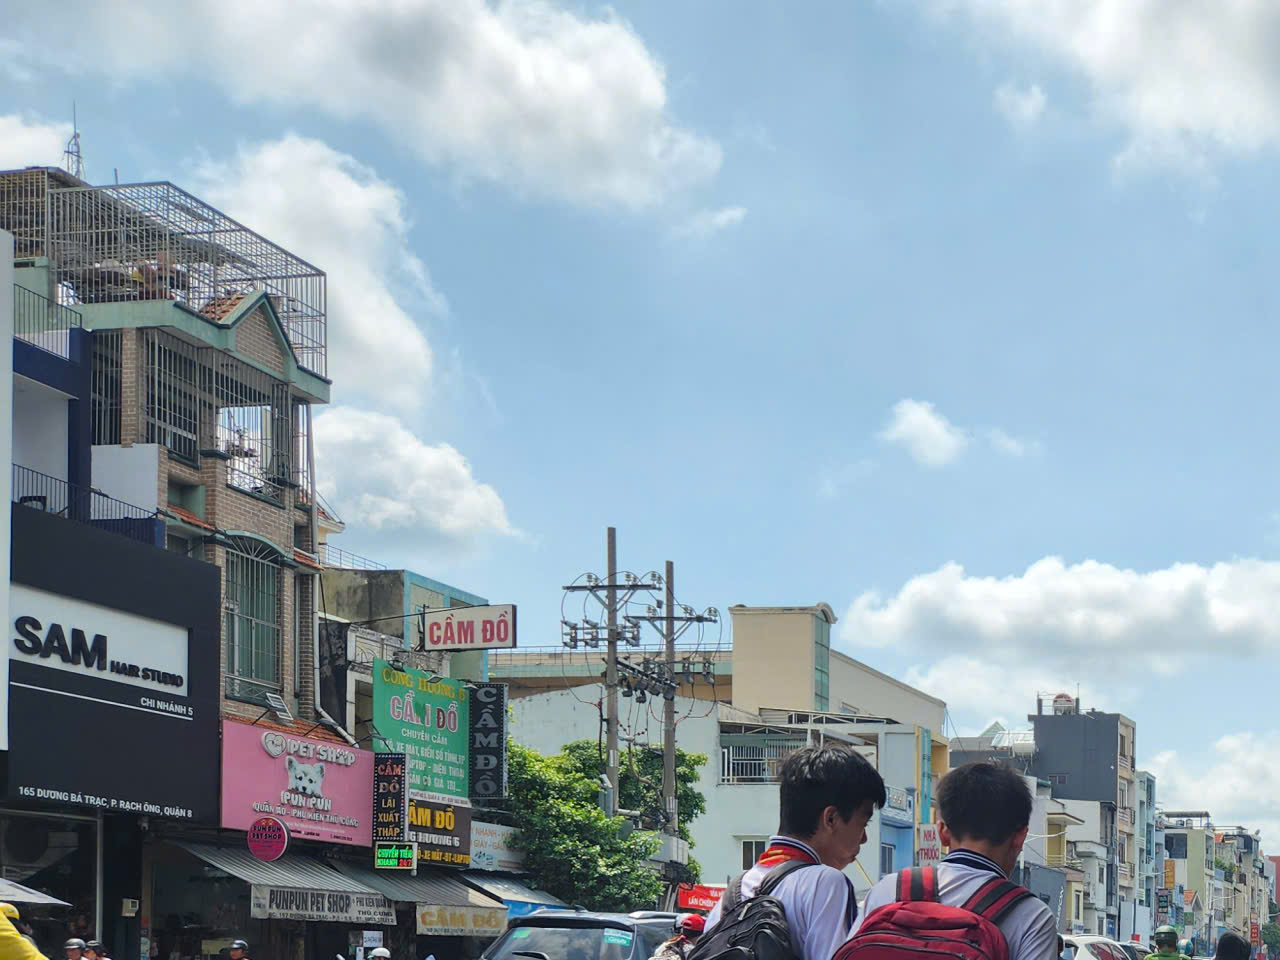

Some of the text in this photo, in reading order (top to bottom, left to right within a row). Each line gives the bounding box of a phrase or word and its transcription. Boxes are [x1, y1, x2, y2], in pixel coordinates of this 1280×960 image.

[428, 610, 509, 646] CẦM ĐỒ
[14, 615, 184, 688] SAM HAIR STUDIO
[140, 697, 193, 716] CHI NHÁNH 5
[436, 700, 459, 732] ĐỒ
[287, 738, 356, 766] PET SHOP
[377, 759, 402, 776] CẦM
[378, 777, 400, 793] ĐỒ
[18, 786, 36, 797] 165
[70, 791, 83, 803] BÁ
[84, 795, 110, 808] TRẠC,
[119, 800, 142, 812] RẠCH
[164, 806, 186, 818] QUẬN
[281, 790, 332, 811] PUN PUN
[377, 810, 401, 822] XUẤT
[408, 800, 456, 831] ẦM ĐỒ
[377, 825, 401, 837] THẤP
[453, 837, 460, 847] 6
[269, 889, 309, 911] PUNPUN
[310, 891, 327, 912] PET
[327, 893, 350, 914] SHOP
